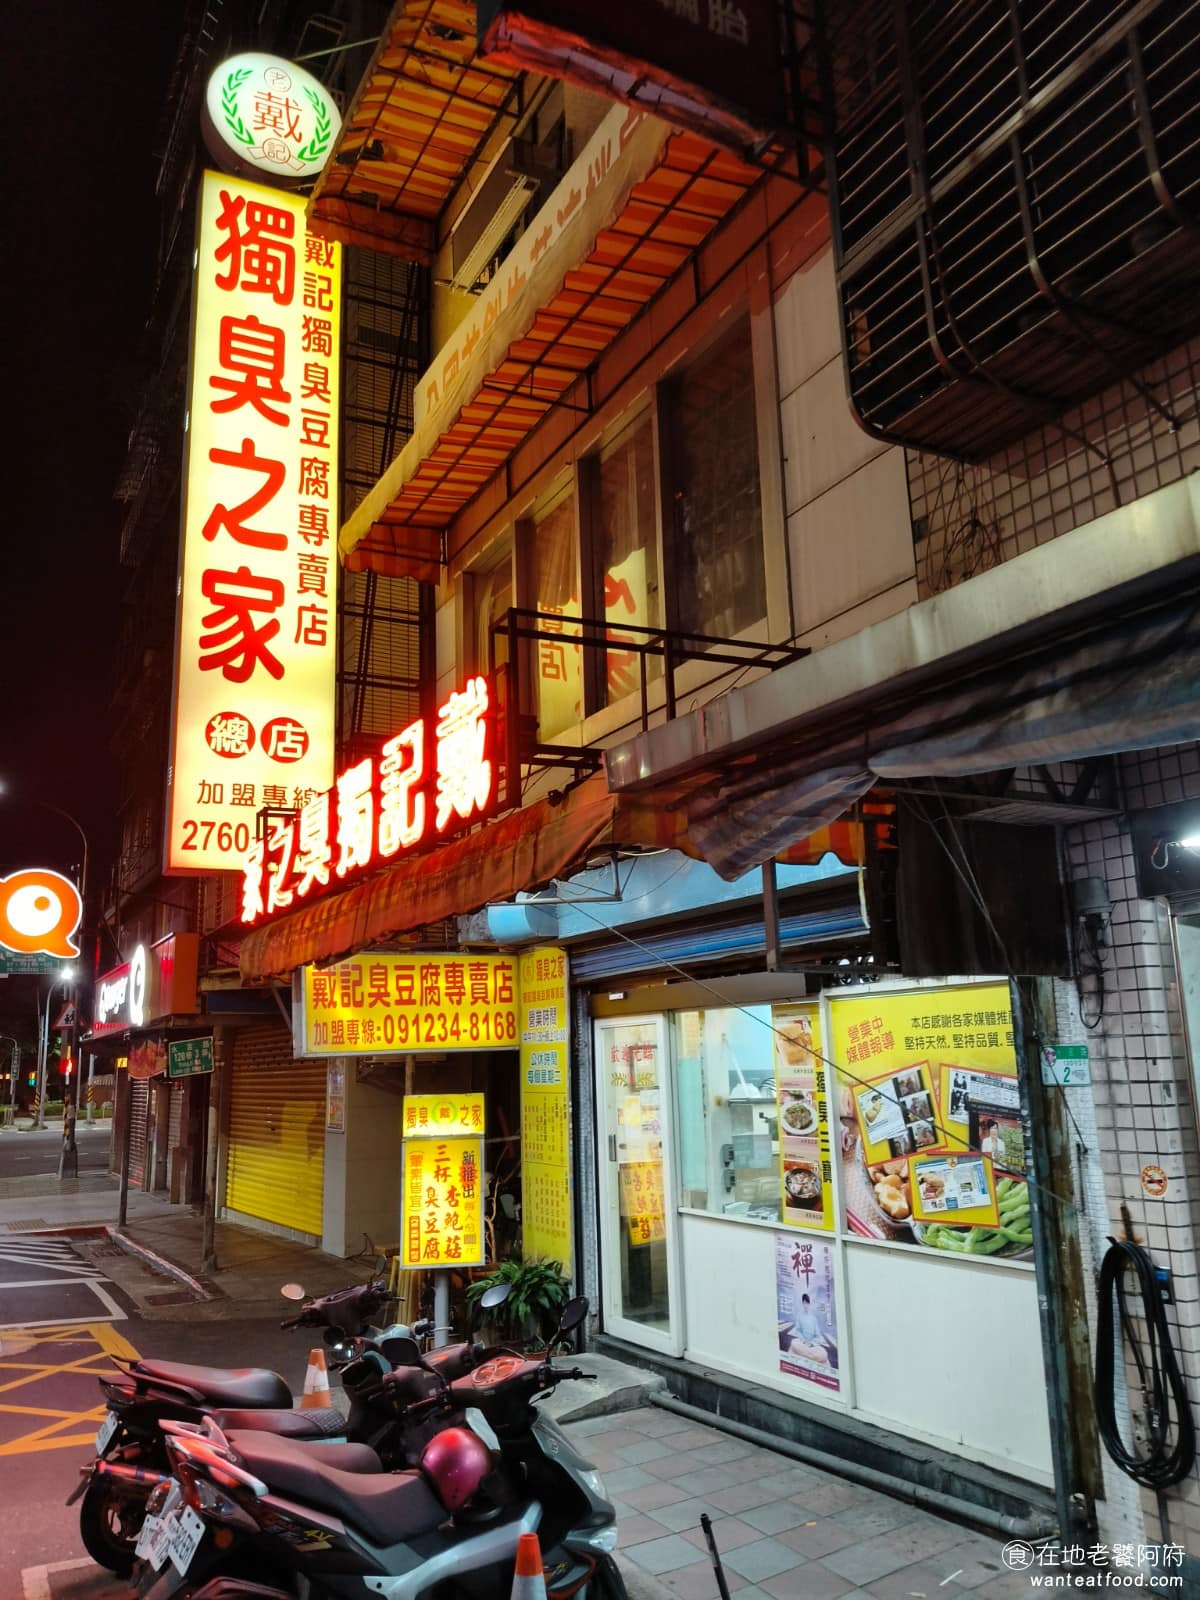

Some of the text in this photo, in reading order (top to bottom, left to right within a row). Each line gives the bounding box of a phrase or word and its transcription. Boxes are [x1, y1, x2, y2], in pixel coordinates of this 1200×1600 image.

[253, 92, 302, 143] 戴
[198, 190, 296, 683] 獨臭之家
[294, 231, 335, 646] 戴記獨臭豆腐專賣店
[312, 961, 514, 1009] 戴記臭豆腐專賣店
[791, 1241, 817, 1289] 禪
